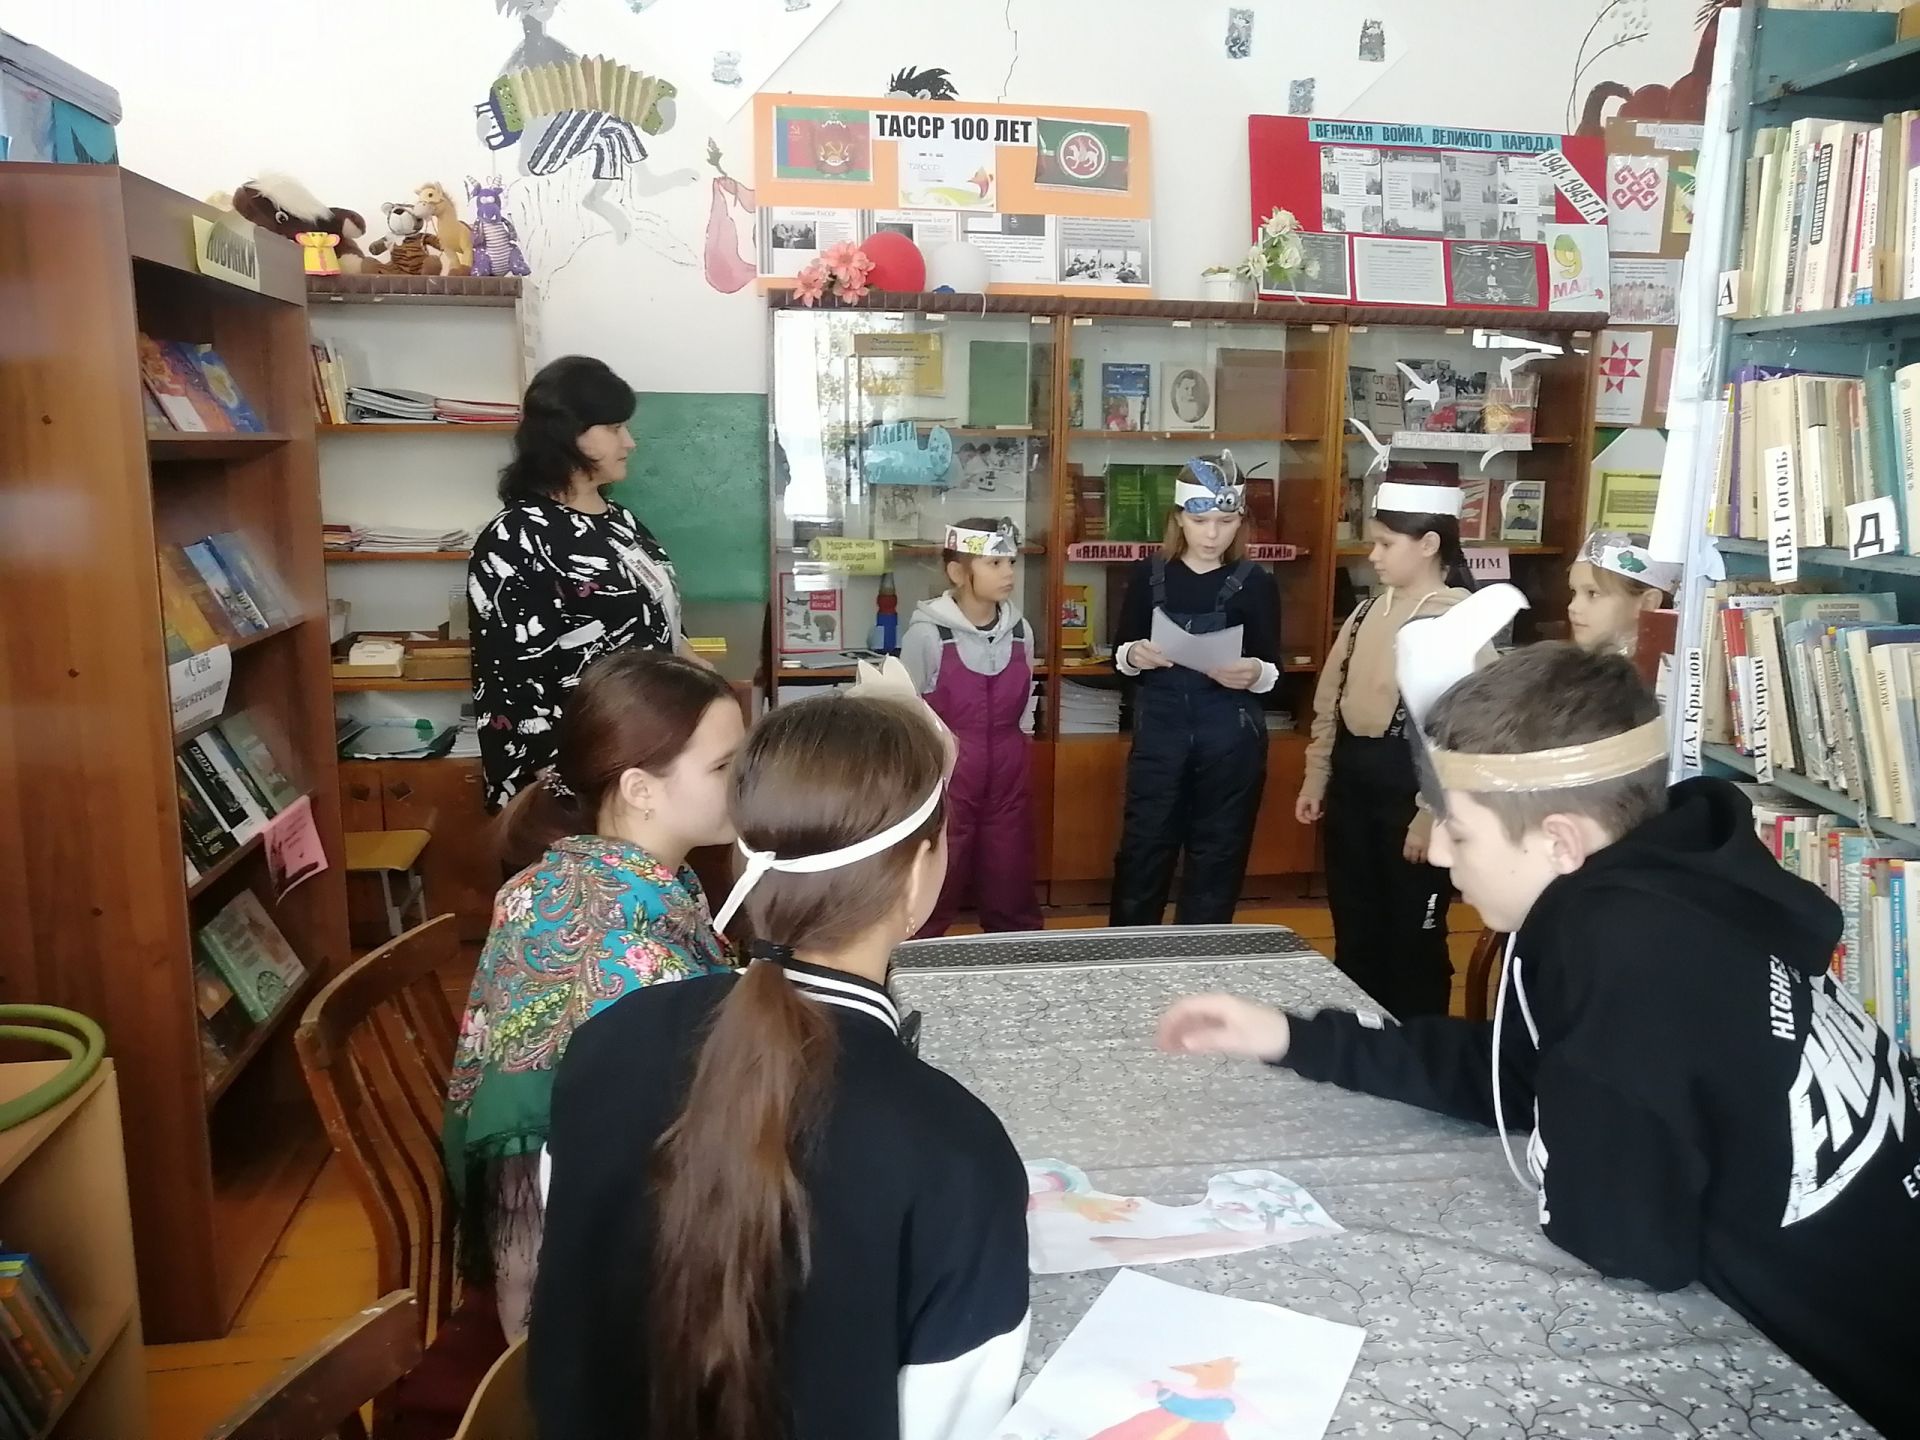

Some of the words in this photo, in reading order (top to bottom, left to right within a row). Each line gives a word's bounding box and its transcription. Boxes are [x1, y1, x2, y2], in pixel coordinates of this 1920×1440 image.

[876, 114, 945, 139] ТАССР
[951, 117, 989, 141] 100
[994, 119, 1032, 143] ЛЕТ
[1315, 123, 1373, 141] ВЕЛИКАЯ
[1432, 128, 1492, 149] ВЕЛИКОГО
[1501, 132, 1554, 153] НАРОДА
[1553, 233, 1584, 279] 9
[1553, 281, 1588, 299] МА
[1717, 276, 1734, 308] А
[1774, 451, 1789, 523] Гоголь
[1776, 528, 1793, 573] Н.В.
[1853, 512, 1884, 558] Д
[1685, 651, 1704, 724] Крылов
[1752, 658, 1769, 733] Куприн
[1683, 729, 1699, 769] И.А.
[1846, 862, 1862, 914] КНИГА
